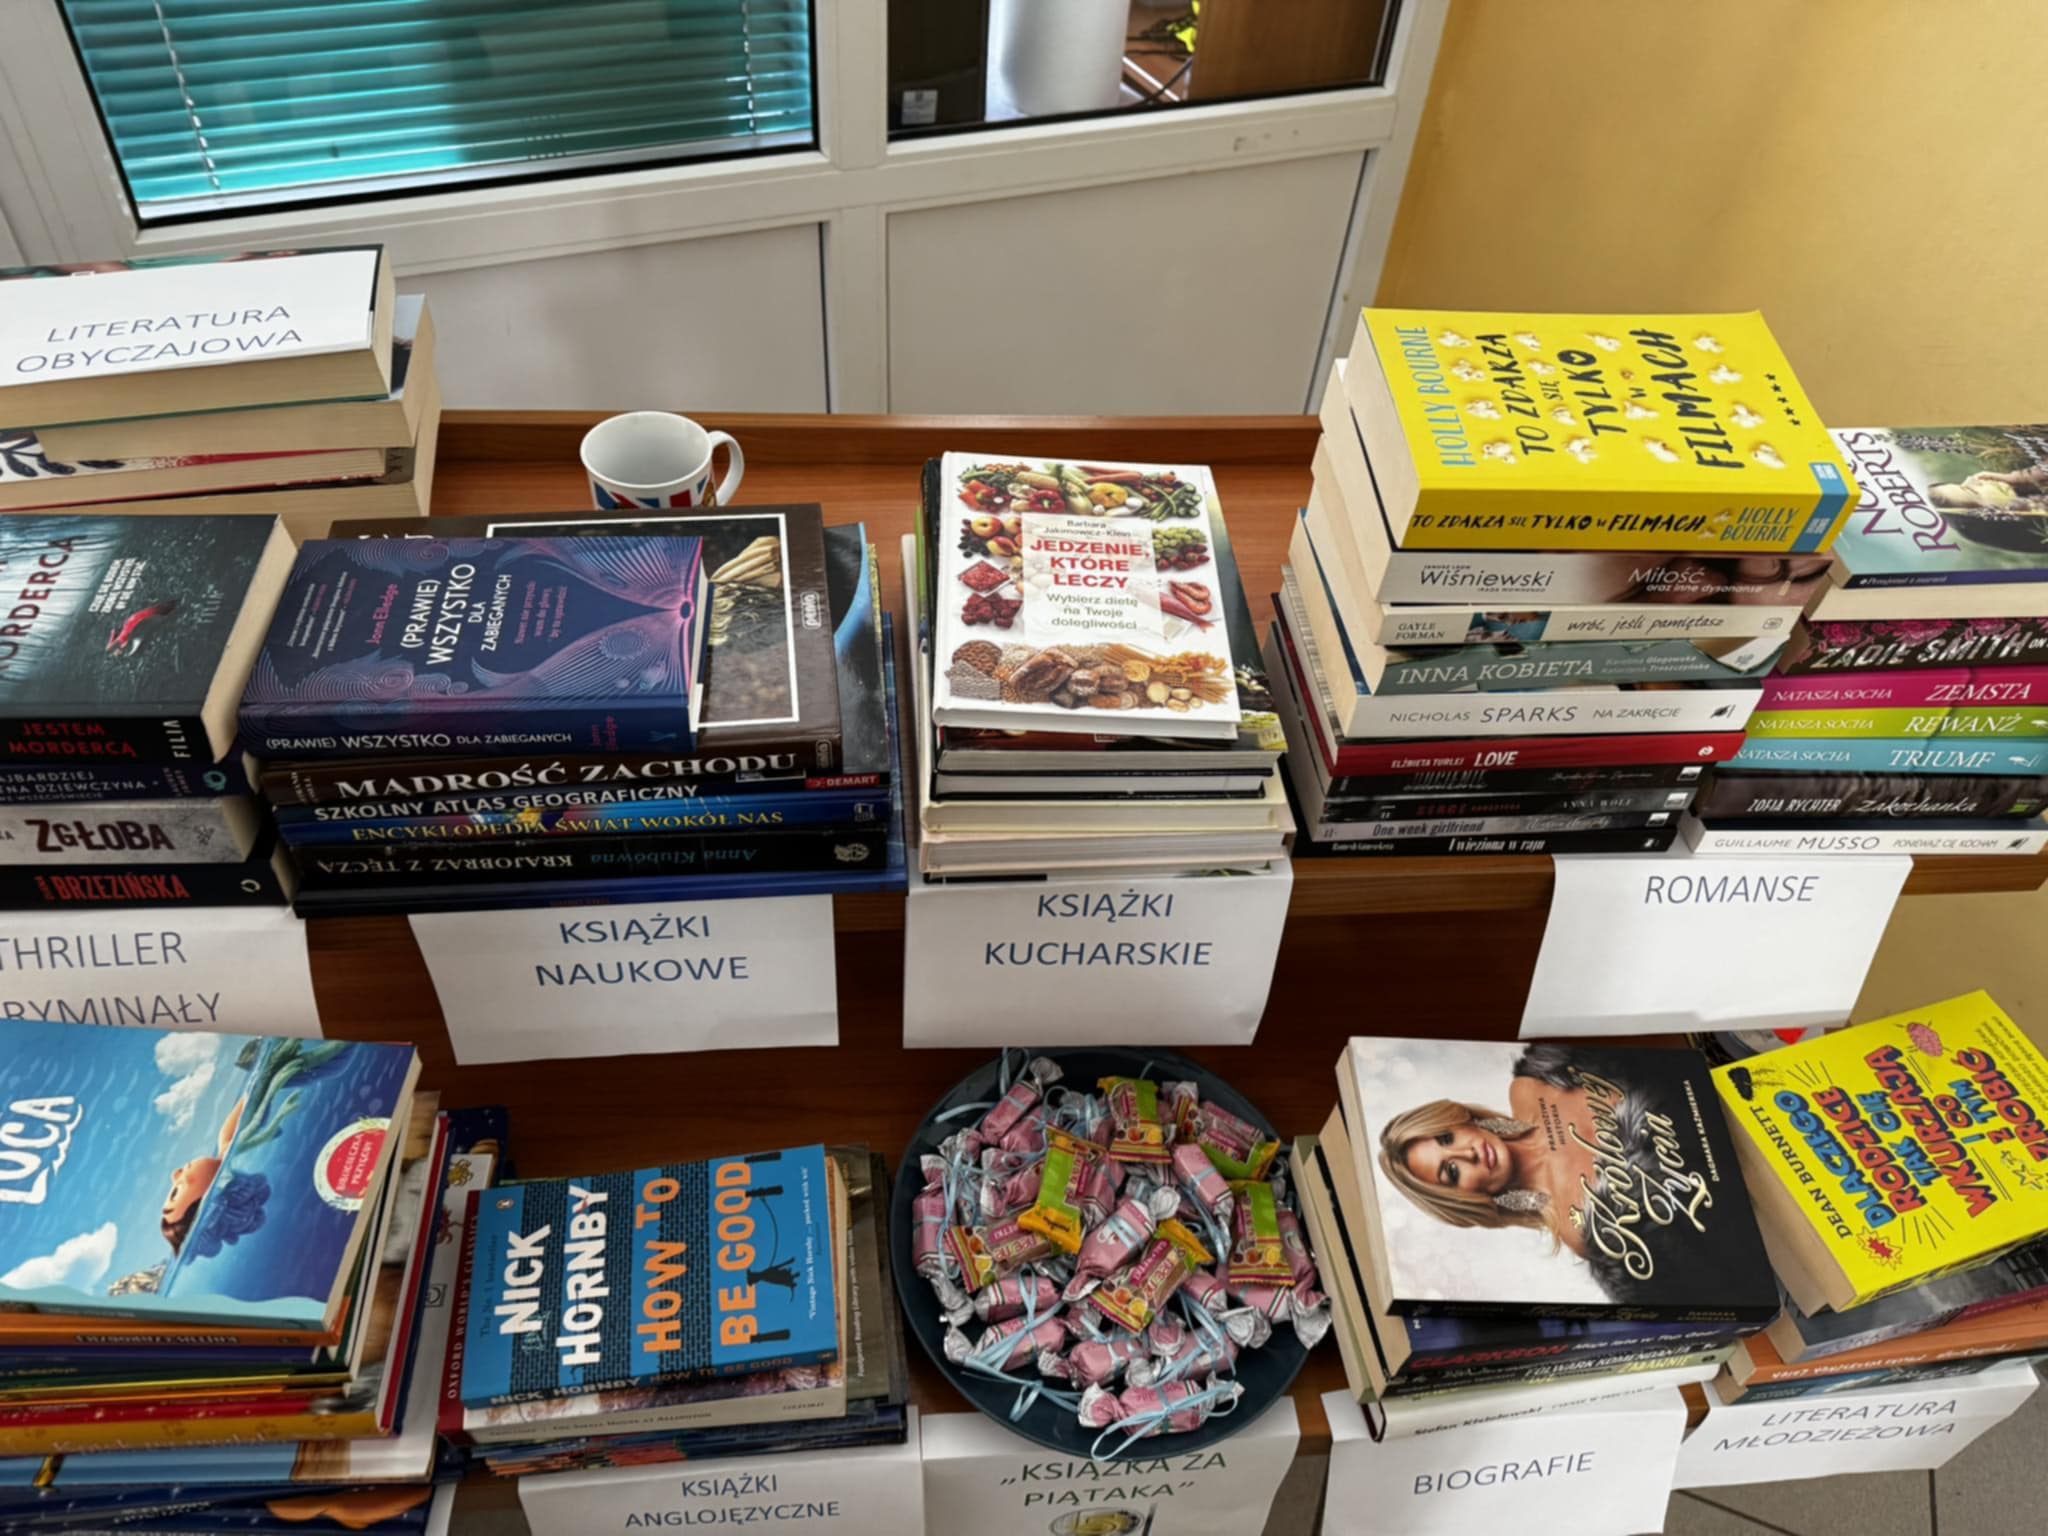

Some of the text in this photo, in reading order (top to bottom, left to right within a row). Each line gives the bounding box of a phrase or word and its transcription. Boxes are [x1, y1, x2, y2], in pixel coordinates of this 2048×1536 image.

[46, 305, 292, 344] LITERATURA
[16, 329, 303, 373] OBYCZAJOWA
[1395, 325, 1477, 467] HOLLY BOURNE
[1475, 332, 1555, 457] TO ZDARZA
[1557, 348, 1628, 439] TYLKO
[1629, 327, 1745, 470] FILMACH
[1840, 432, 1961, 552] ROBERTS
[1412, 514, 1707, 532] TO ZDARZA TYLKO FILMACH
[1736, 506, 1799, 524] HOLLY
[1719, 525, 1794, 542] BOURNE
[1030, 539, 1151, 558] JEDZENIE,
[1050, 555, 1129, 572] KTÓRE
[1420, 568, 1554, 587] Wiśniewski
[1628, 566, 1705, 585] Miłość
[1053, 573, 1129, 589] LECZY
[1646, 584, 1764, 595] oraz inne dysonanse
[400, 579, 442, 648] (PRAWIE)
[426, 563, 476, 665] WSZYSTKO
[468, 601, 486, 623] DLA
[481, 574, 512, 652] ZABIEGANYCH
[1047, 593, 1138, 608] Wybierz dietę
[1063, 605, 1123, 618] na Twoje
[1051, 617, 1137, 632] dolegliwości
[1395, 631, 1445, 640] FORMAN
[1398, 623, 1436, 631] GAYLE
[1610, 615, 1645, 635] jeśli
[1646, 616, 1725, 635] pamiętasz
[1809, 632, 2032, 669] ZADIE SMITH
[1396, 660, 1594, 684] INNA KOBIETA
[1774, 683, 2032, 702] NATASZA SOCHA ZEMSTA
[22, 722, 106, 736] JESTEM
[1390, 706, 1682, 724] NICHOLAS SPARKS NA ZAKRĘCIE
[1756, 713, 2023, 732] NATASZA SOCHA REWANŻ
[8, 740, 137, 758] MORDERCĄ
[267, 733, 572, 749] (PRAWIE) WSZYSTKO DLA ZABIEGANYCH
[1473, 751, 1519, 767] LOVE
[1735, 748, 1995, 768] NATASZA SOCHA TRIUMF
[35, 781, 146, 793] DZIEWCZYNA
[334, 762, 567, 799] MĄDROŚĆ
[580, 753, 796, 783] ZACHODU
[826, 775, 877, 788] DEMART
[314, 785, 699, 821] SZKOLNY ATLAS GEOGRAFICZNY
[1747, 796, 1979, 816] ZOFIA RYCHTER Zakochanka
[25, 819, 175, 852] ZGŁOBA
[352, 811, 784, 841] ENCYKLOPEDIA ŚWIAT WOKÓŁ NAS
[1372, 820, 1485, 837] One week girlfriend
[703, 849, 757, 862] Anna
[1714, 836, 1880, 849] GUILLAUME MUSSO
[406, 860, 423, 872] Z
[431, 855, 572, 871] KRAJOBRAZ
[51, 872, 191, 901] BRZEZIŃSKA
[1644, 875, 1820, 904] ROMANSE
[1037, 888, 1173, 923] KSIĄŻKI
[560, 913, 710, 946] KSIĄŻKI
[984, 941, 1214, 967] KUCHARSKIE
[535, 956, 750, 987] NAUKOWE
[1948, 1079, 1998, 1124] TYM
[1951, 1046, 2048, 1162] ZROBIĆ
[1550, 1104, 1565, 1145] HISTORIA
[1864, 1044, 1998, 1218] WKURZAJĄ
[1934, 1094, 1986, 1144] I CO
[0, 1095, 76, 1205] LUCA
[1812, 1086, 1928, 1213] RODZICE
[1855, 1090, 1942, 1186] TAK CIĘ
[1986, 1127, 2014, 1144] Z
[1566, 1065, 1653, 1280] Królowej
[1632, 1111, 1712, 1232] Życia
[1699, 1137, 1720, 1182] DAGMARA
[1750, 1106, 1853, 1238] DEAN BURNETT
[1774, 1090, 1896, 1229] DLACZEGO
[636, 1177, 688, 1353] HOW TO
[715, 1161, 757, 1346] BE GOOD
[494, 1224, 551, 1335] NICK
[557, 1185, 609, 1366] HORNBY
[447, 1340, 465, 1399] OXFORD
[457, 1275, 469, 1336] WORLD'S
[490, 1390, 542, 1407] NICK
[553, 1376, 641, 1396] HORNBY
[649, 1368, 697, 1383] HOW
[748, 1356, 793, 1371] GOOD
[1762, 1399, 1958, 1427] LITERATURA
[1713, 1422, 1955, 1451] MŁODZIEŻOWA
[1182, 1452, 1227, 1472] ZA
[1413, 1451, 1596, 1496] BIOGRAFIE
[681, 1473, 778, 1500] KSIĄŻKI
[625, 1501, 841, 1529] ANGLOJĘZYCZNE
